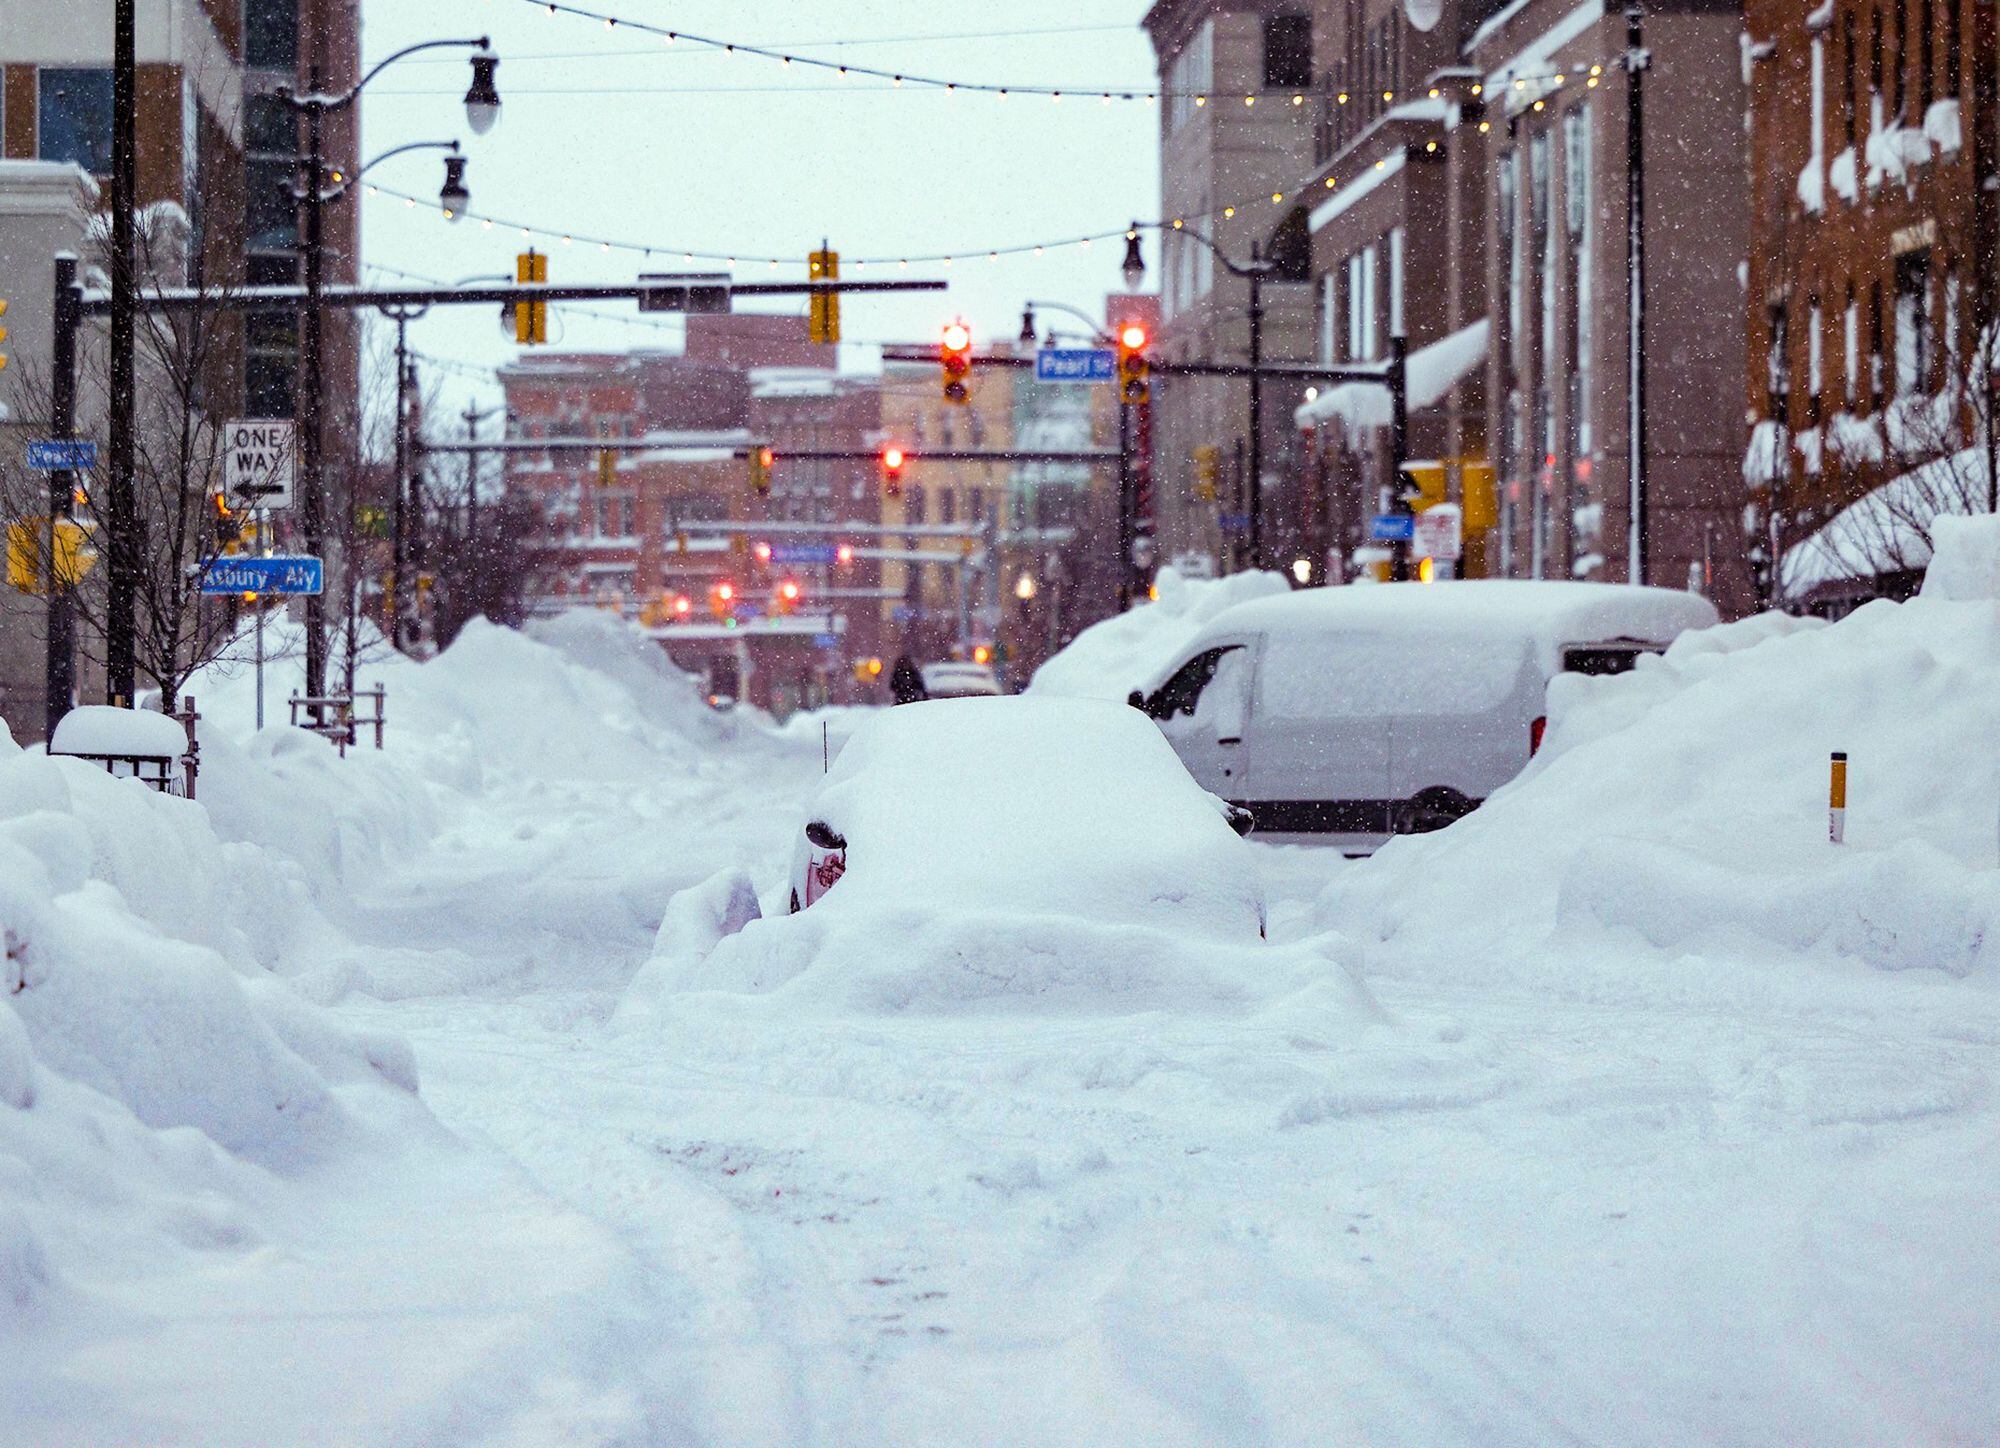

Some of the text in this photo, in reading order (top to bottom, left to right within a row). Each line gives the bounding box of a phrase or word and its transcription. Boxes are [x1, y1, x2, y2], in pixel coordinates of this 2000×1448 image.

[1042, 355, 1090, 374] Pearl
[236, 429, 281, 448] ONE
[237, 453, 282, 472] WAY
[203, 566, 316, 592] Asbury Aly
